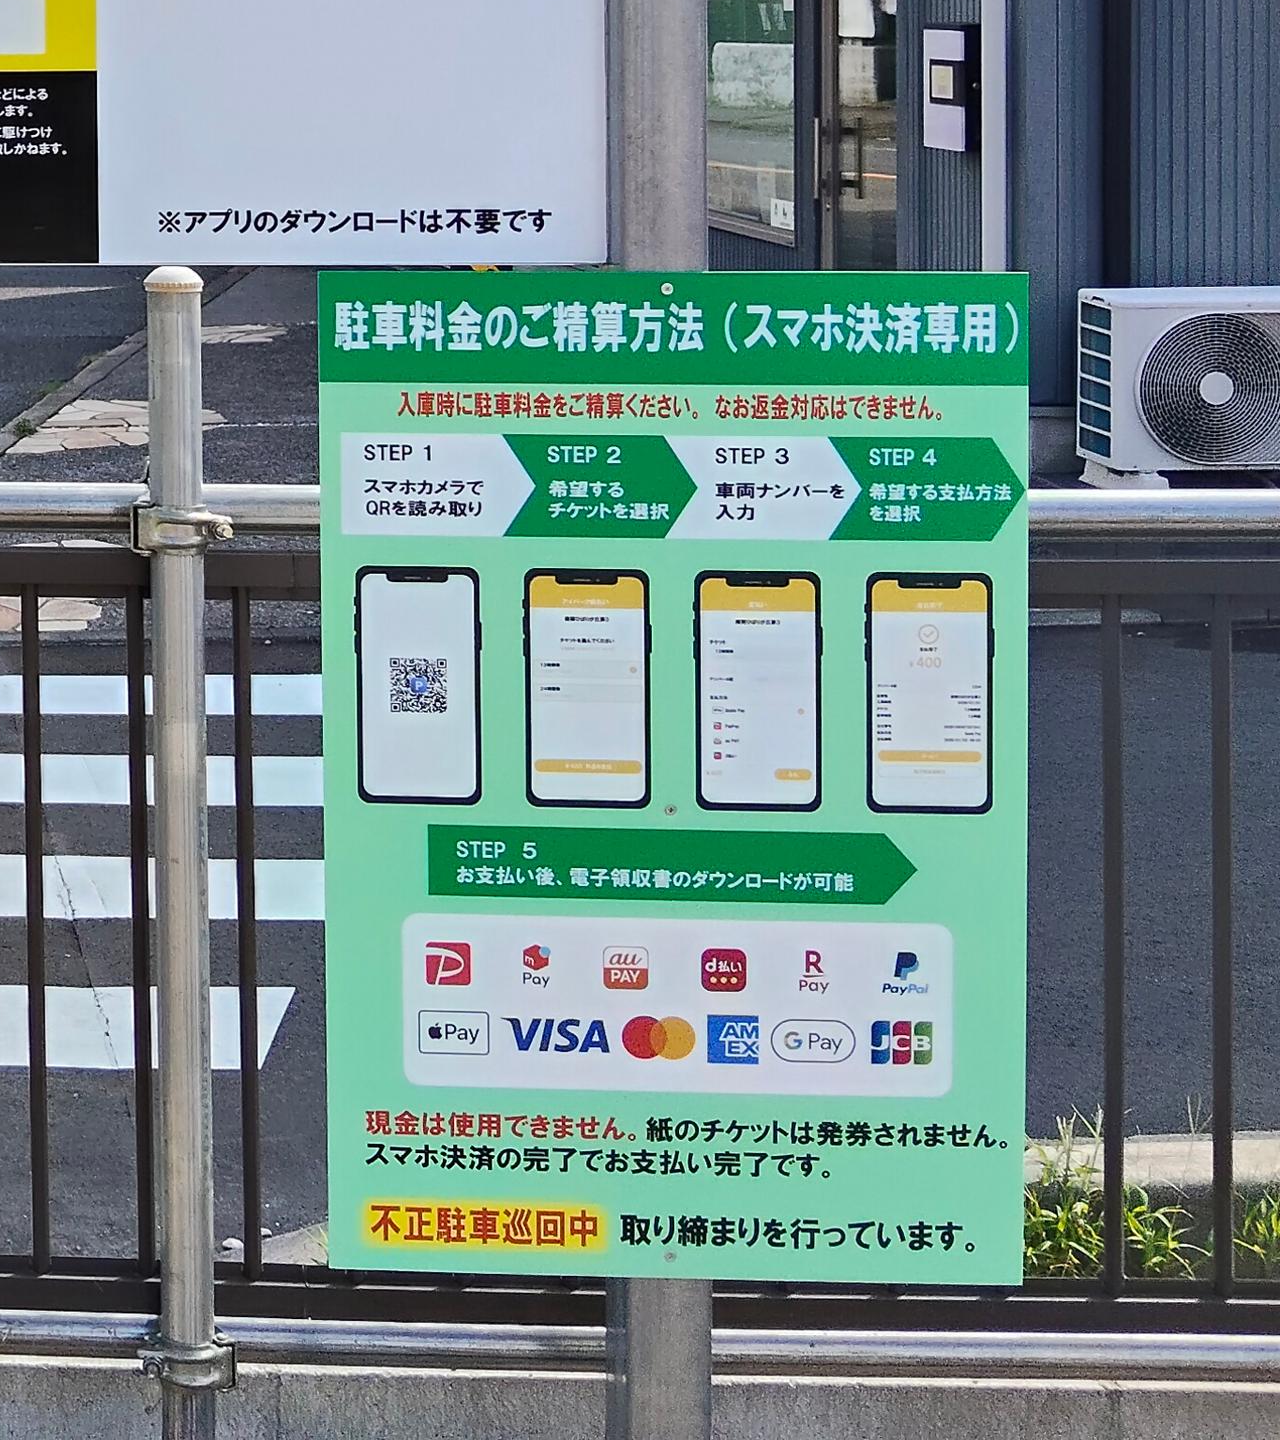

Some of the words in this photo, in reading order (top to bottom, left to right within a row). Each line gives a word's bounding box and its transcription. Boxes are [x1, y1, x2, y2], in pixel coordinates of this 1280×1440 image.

[159, 209, 552, 234] ※アプリのダウンロードは不要です
[335, 301, 1018, 354] 駐車料金のご精算方法（スマホ決済専用）
[364, 444, 412, 460] STEP
[424, 445, 431, 461] 1
[548, 446, 597, 463] STEP
[607, 447, 621, 463] 2
[716, 448, 765, 464] STEP
[775, 448, 789, 464] 3
[869, 448, 914, 465] STEP
[922, 449, 937, 465] 4
[364, 480, 483, 495] スマホカメラで
[549, 480, 624, 497] 希望する
[716, 482, 844, 499] 車両ナンバーを
[869, 483, 1011, 501] 希望する支払方法
[366, 500, 481, 517] QRを読み取り
[548, 503, 669, 520] チケットを選択
[716, 504, 754, 520] 入力
[870, 505, 921, 522] を選択
[457, 841, 505, 858] STEP
[523, 842, 536, 859] 5
[457, 866, 853, 891] お支払い後、電子領収書のダウンロードが可能
[607, 950, 642, 968] au
[705, 957, 743, 973] d払い
[523, 972, 549, 988] Pay
[610, 970, 641, 984] PAY
[799, 980, 829, 994] Pay
[882, 981, 929, 995] PayPal
[445, 1024, 479, 1044] Pay
[501, 1018, 610, 1053] VISA
[809, 1033, 842, 1054] Pay
[366, 1144, 830, 1178] スマホ決済の完了でお支払い完了です。
[372, 1205, 599, 1248] 不正駐車巡回中
[620, 1215, 975, 1252] 取り締まりを行っています。
